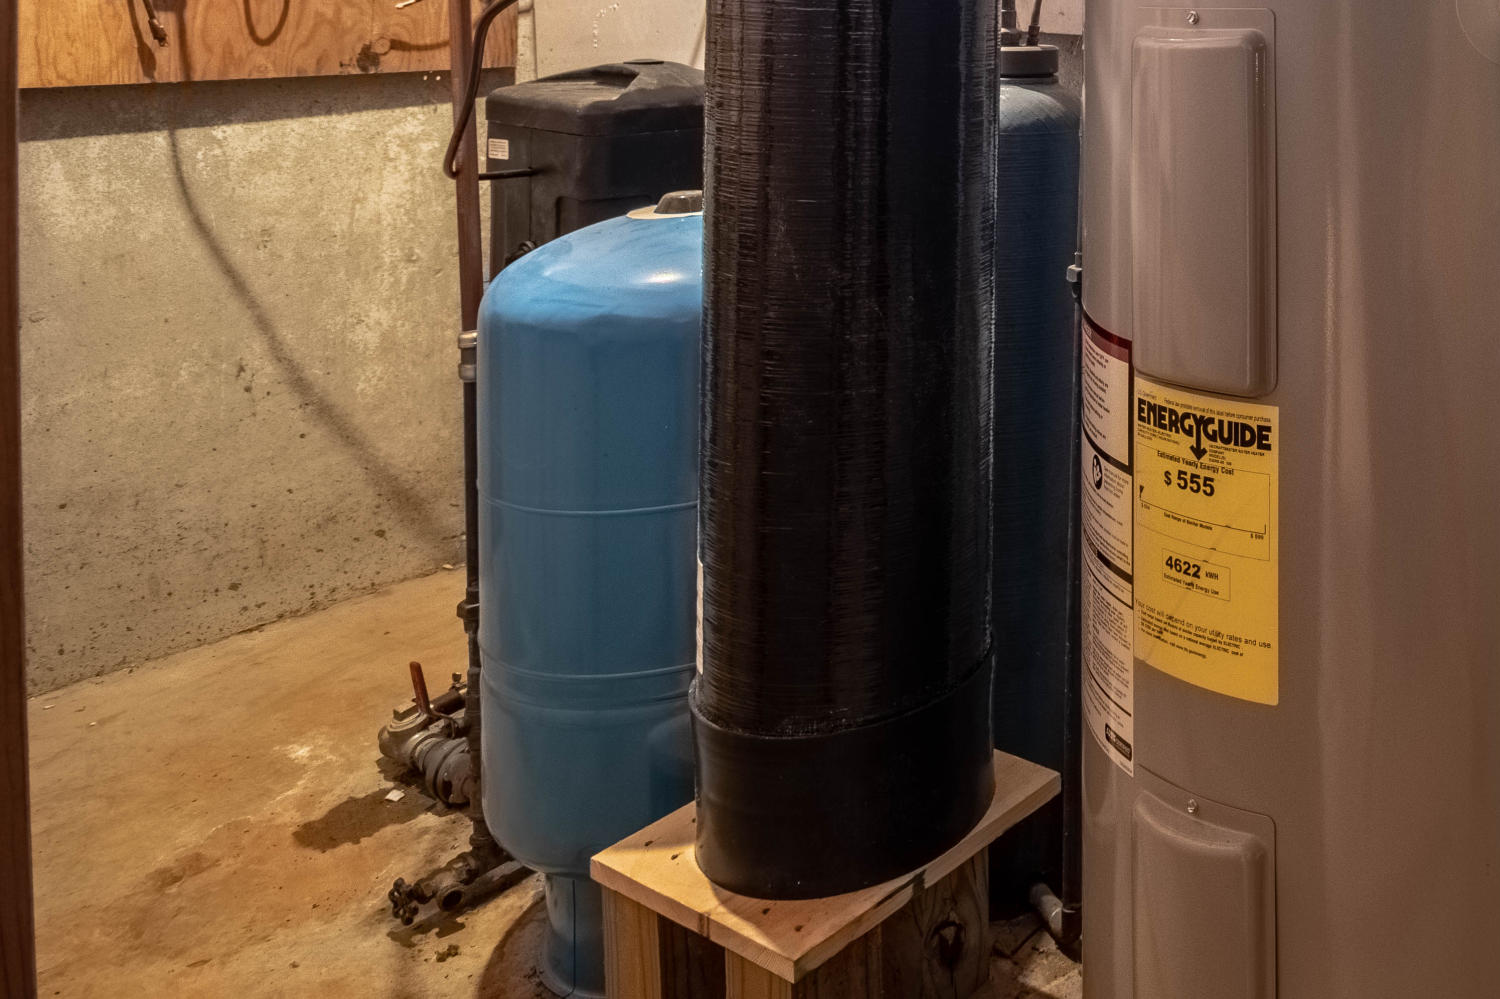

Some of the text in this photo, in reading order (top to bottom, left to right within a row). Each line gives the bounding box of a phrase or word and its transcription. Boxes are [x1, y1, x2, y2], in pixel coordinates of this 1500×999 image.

[1138, 397, 1272, 452] ENERGYGUIDE
[1157, 450, 1181, 463] Estimated
[1182, 456, 1198, 469] Yearly
[1200, 461, 1219, 474] Energy
[1221, 466, 1234, 475] Cost
[1164, 469, 1215, 497] $ 555
[1165, 555, 1201, 579] 4622
[1195, 583, 1210, 594] Energy
[1146, 604, 1156, 614] cost
[1194, 625, 1208, 633] your
[1209, 629, 1225, 639] utility
[1226, 633, 1242, 642] rates
[1244, 638, 1256, 646] and
